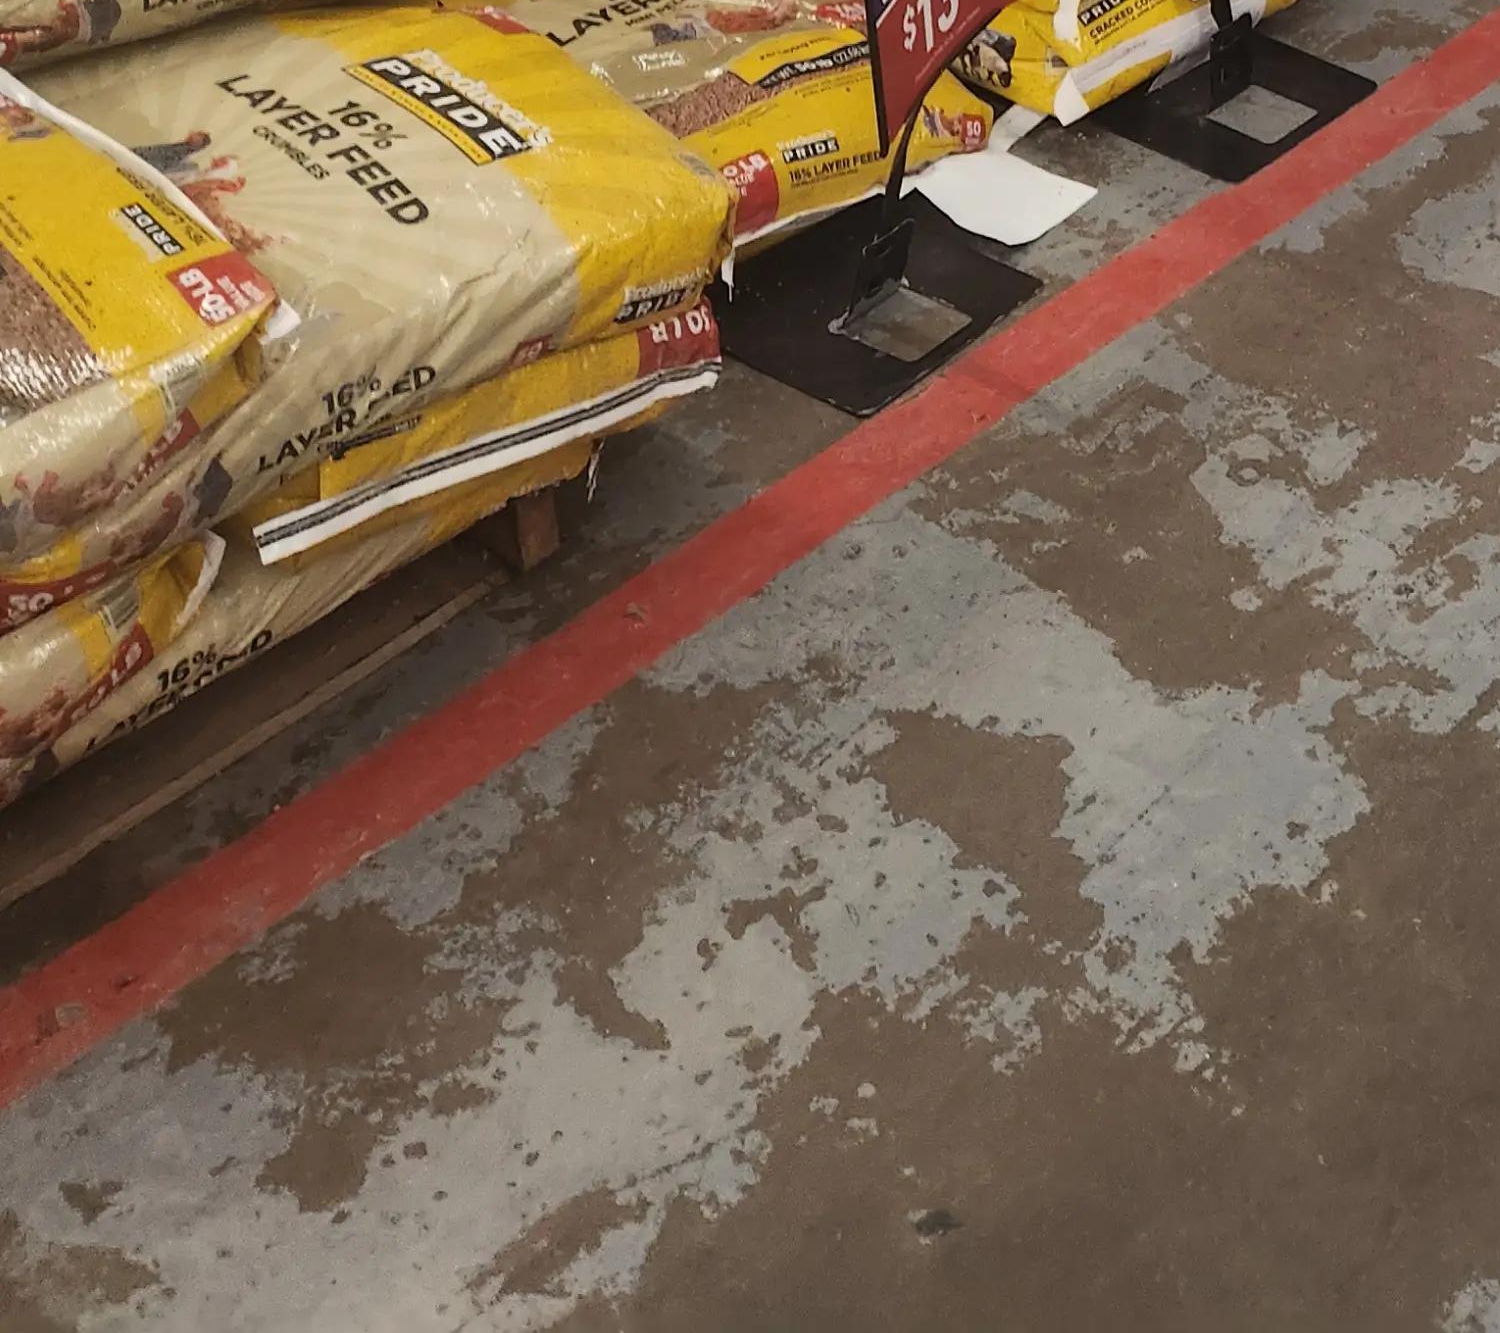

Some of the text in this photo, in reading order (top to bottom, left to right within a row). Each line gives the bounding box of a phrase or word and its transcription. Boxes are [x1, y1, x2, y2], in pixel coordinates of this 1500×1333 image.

[1089, 6, 1134, 39] CRACKED
[327, 100, 407, 149] 16%
[371, 58, 526, 159] PRIDE
[401, 48, 554, 148] Producer's
[215, 74, 341, 147] LAYER
[326, 145, 430, 225] FEED
[253, 124, 331, 180] CRUMBLES
[781, 136, 841, 165] PRIDE
[788, 150, 882, 183] 16% LAYER FEED
[122, 202, 186, 257] PRIDE
